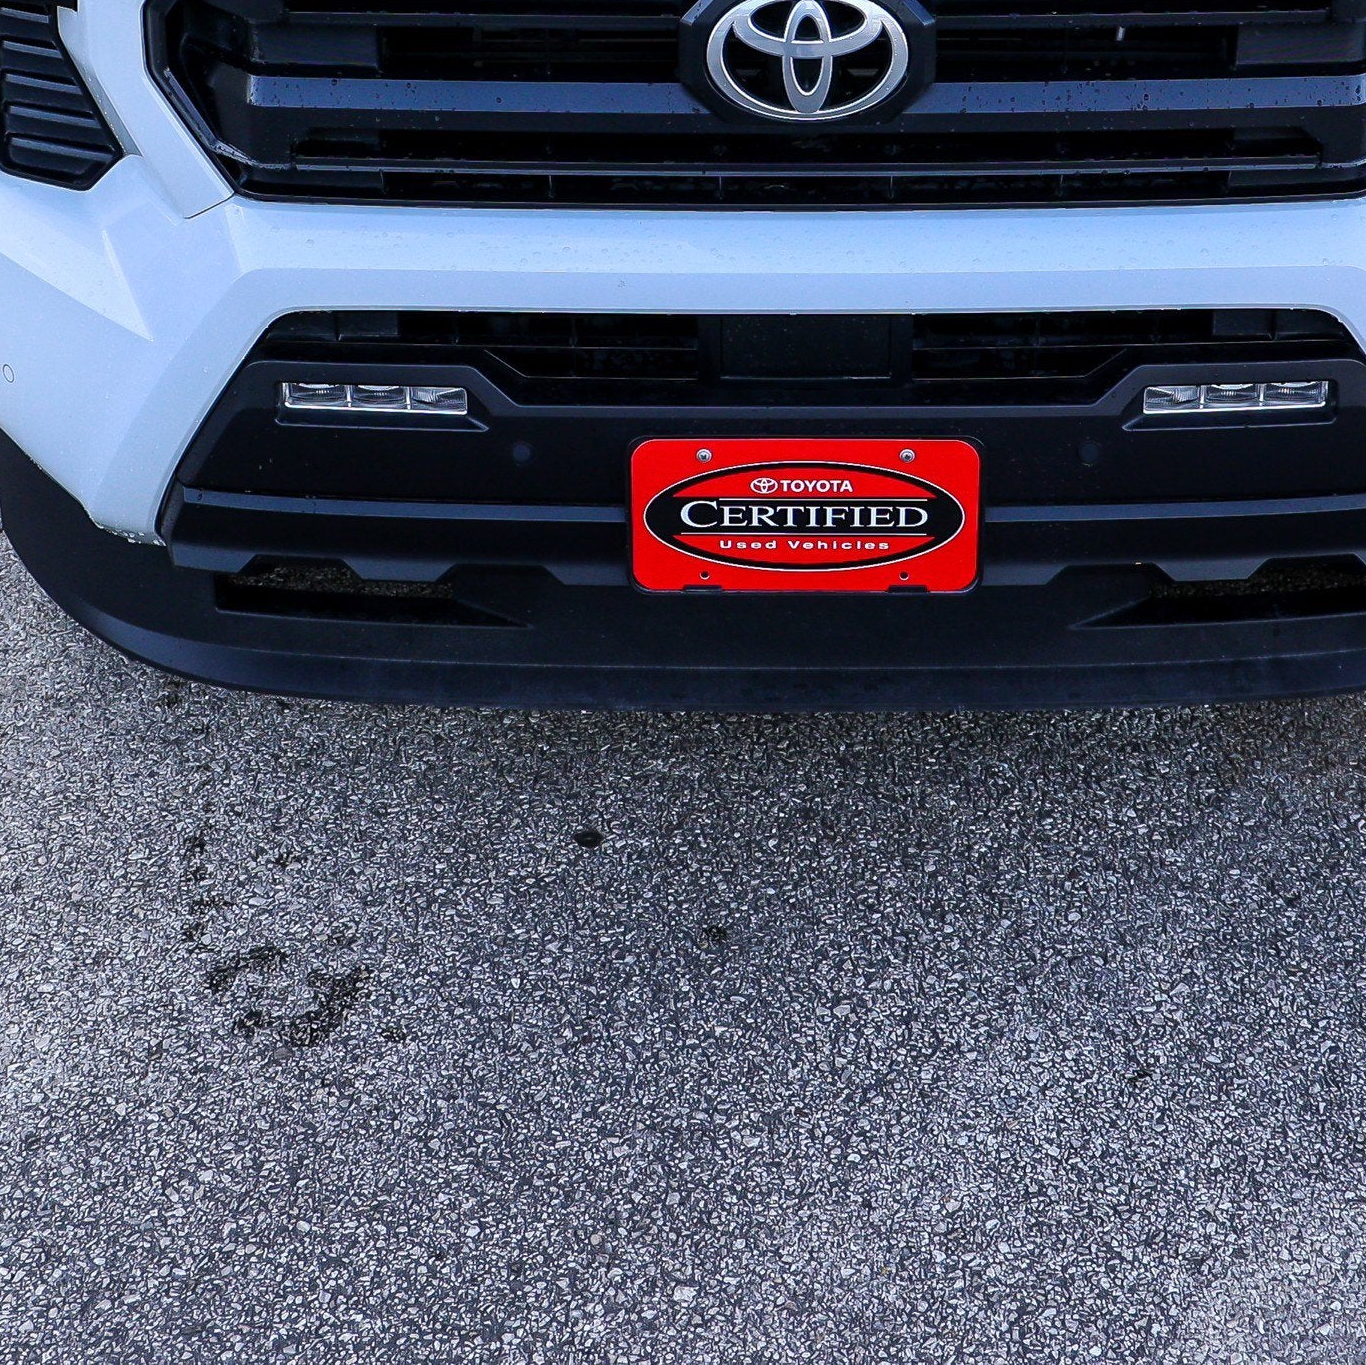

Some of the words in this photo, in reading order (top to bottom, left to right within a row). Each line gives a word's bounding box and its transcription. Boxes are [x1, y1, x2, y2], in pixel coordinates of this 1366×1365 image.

[779, 478, 854, 494] TOYOTA
[679, 500, 929, 529] CERTIFIED
[719, 539, 777, 550] Used
[787, 539, 890, 551] Vehicles
